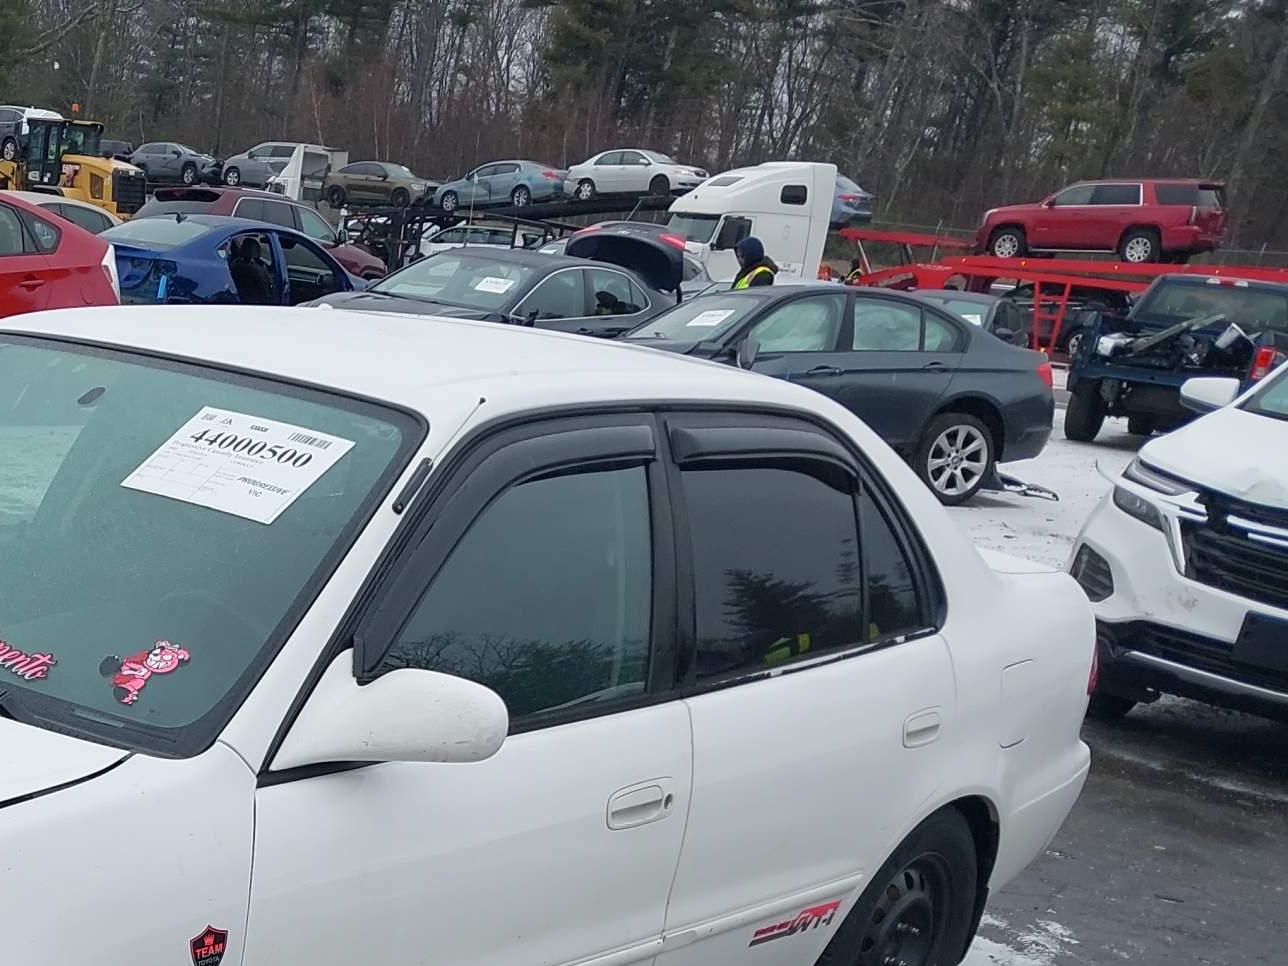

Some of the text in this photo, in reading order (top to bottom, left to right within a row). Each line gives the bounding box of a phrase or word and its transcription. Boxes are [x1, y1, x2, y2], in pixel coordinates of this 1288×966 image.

[190, 428, 313, 469] 44000500
[195, 943, 223, 960] TEAM
[198, 955, 220, 966] TOYOTA
